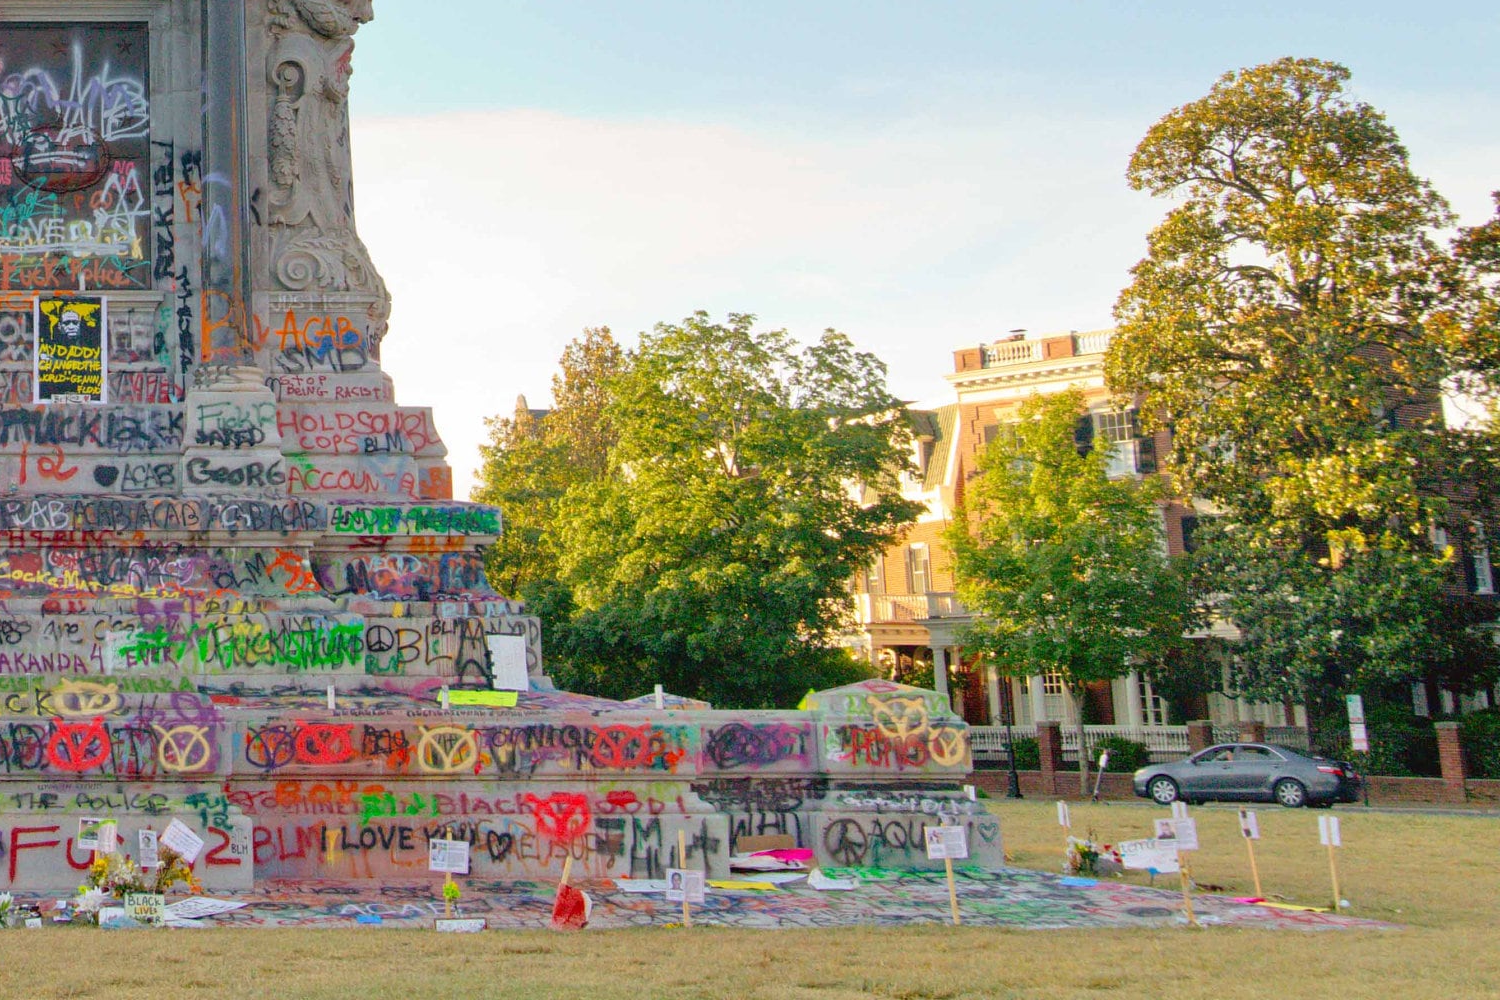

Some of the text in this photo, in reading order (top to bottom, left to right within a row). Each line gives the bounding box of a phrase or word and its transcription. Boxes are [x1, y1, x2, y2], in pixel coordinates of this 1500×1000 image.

[276, 308, 363, 351] ACAB
[276, 409, 355, 438] HOLD
[19, 444, 79, 486] 12
[90, 643, 105, 674] 4
[341, 825, 415, 851] LOVE
[127, 895, 162, 906] BLACK
